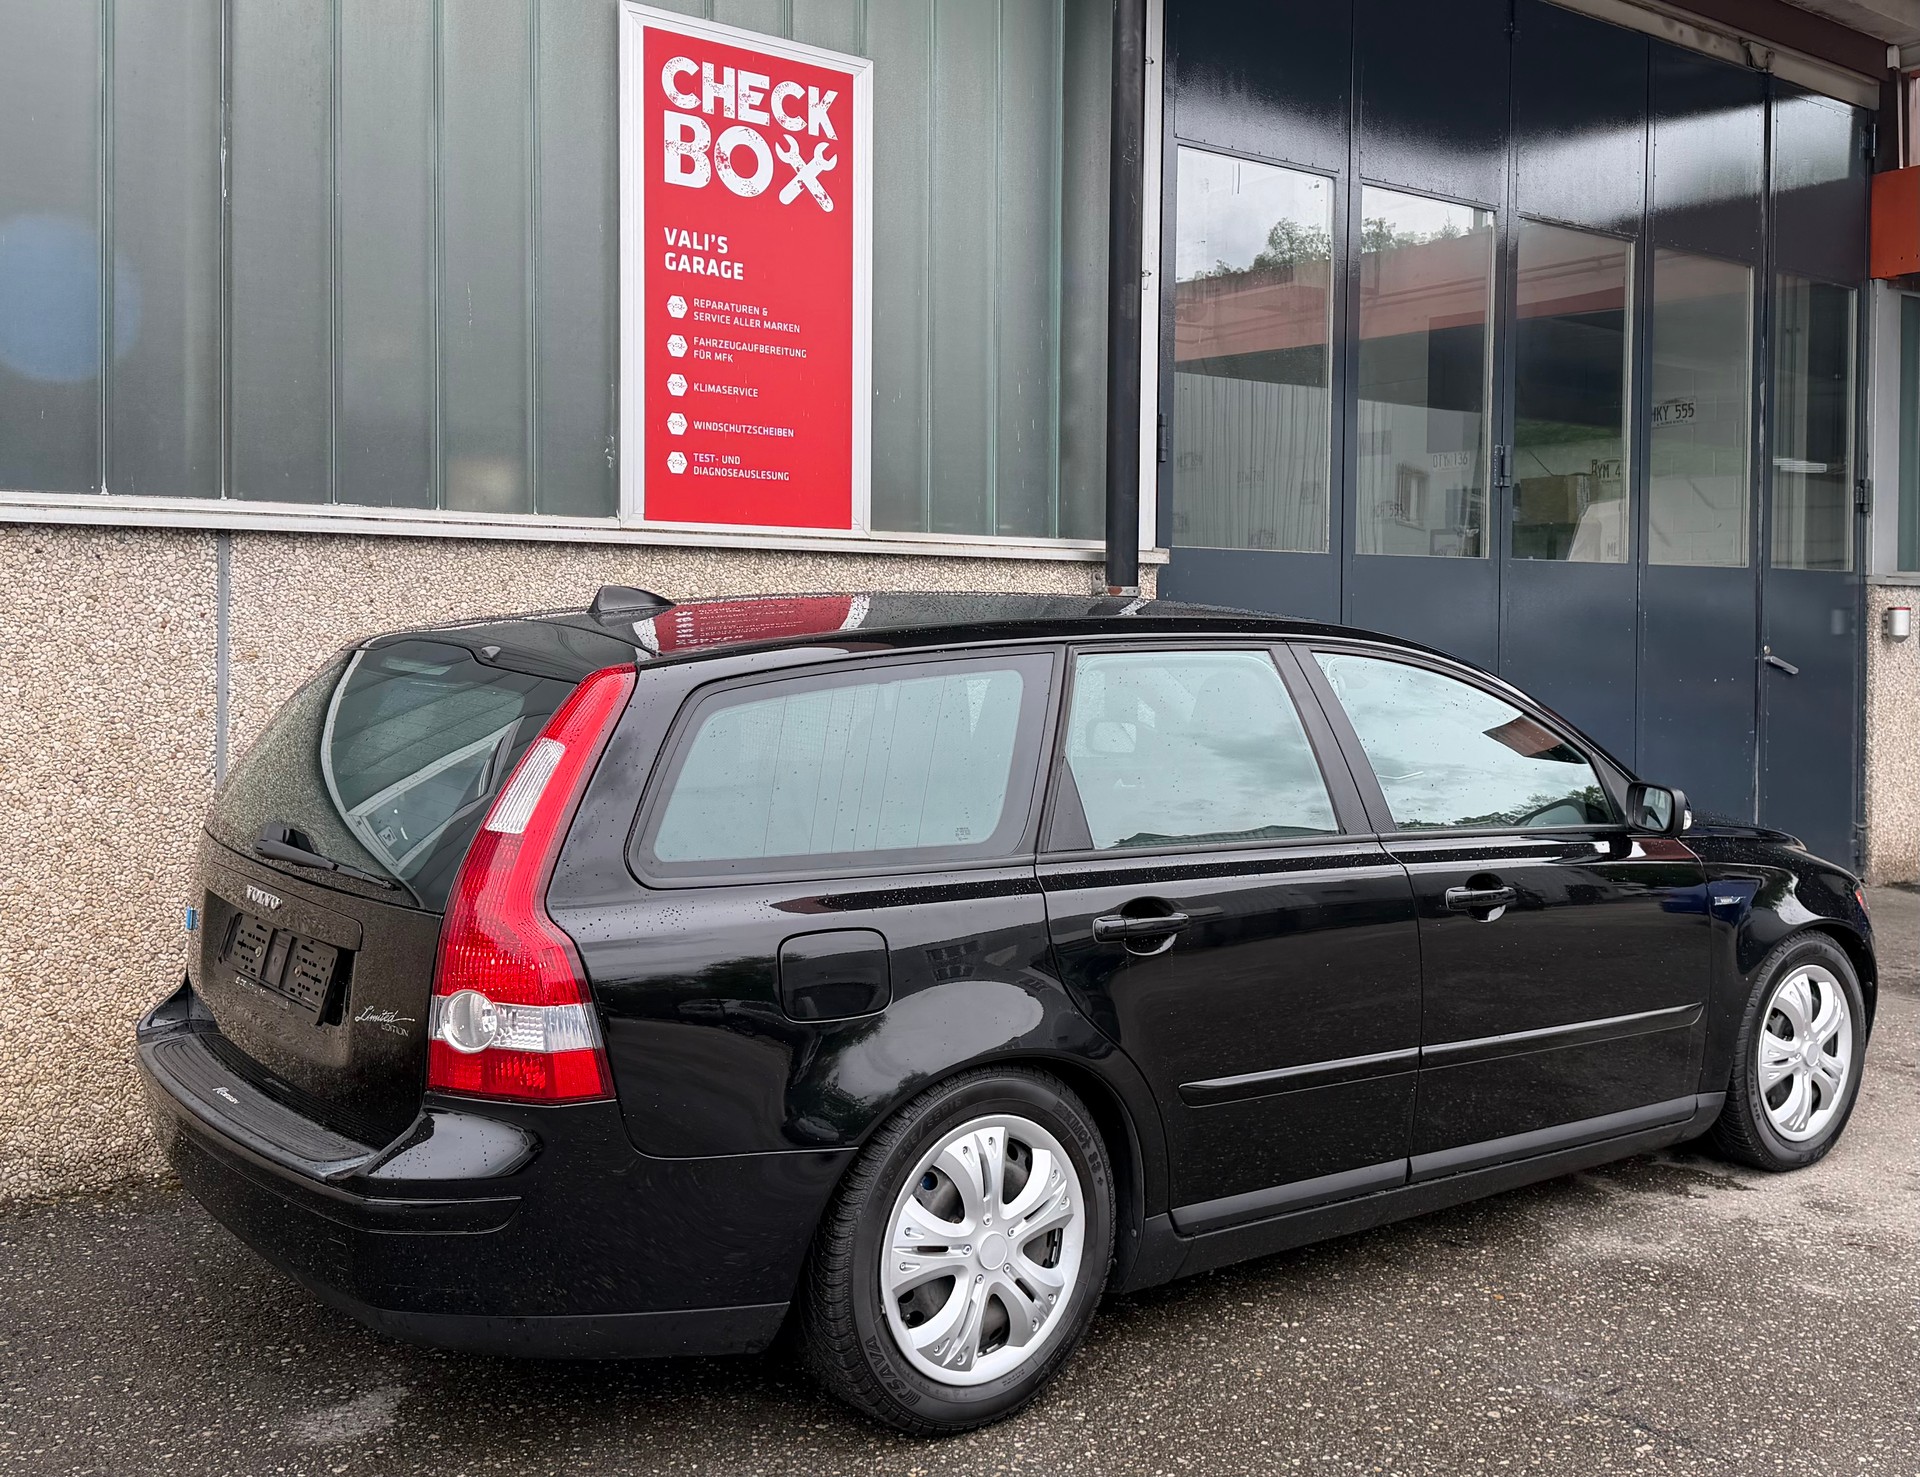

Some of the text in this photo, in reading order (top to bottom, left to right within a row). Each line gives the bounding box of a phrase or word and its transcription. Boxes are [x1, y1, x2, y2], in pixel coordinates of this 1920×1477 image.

[661, 56, 839, 141] CHECK
[663, 226, 729, 254] VALI'S
[664, 252, 744, 281] GARAGE
[693, 297, 768, 317] REPARATUREN &
[693, 311, 801, 334] SERVICE ALLER MARKEN
[693, 336, 808, 359] FAHRZEUGAUFBEREITUNG
[693, 348, 734, 363] FÜR MFK
[693, 382, 759, 398] KLIMASERVICE
[1675, 402, 1694, 419] 555
[693, 420, 795, 438] WINDSCHUTZSCHEIBEN
[693, 452, 741, 465] TEST- UND
[693, 465, 790, 481] DIAGNOSEAUSLESUNG
[354, 1004, 416, 1023] Limited
[380, 1022, 410, 1038] EDITION
[865, 1334, 908, 1393] SAVA
